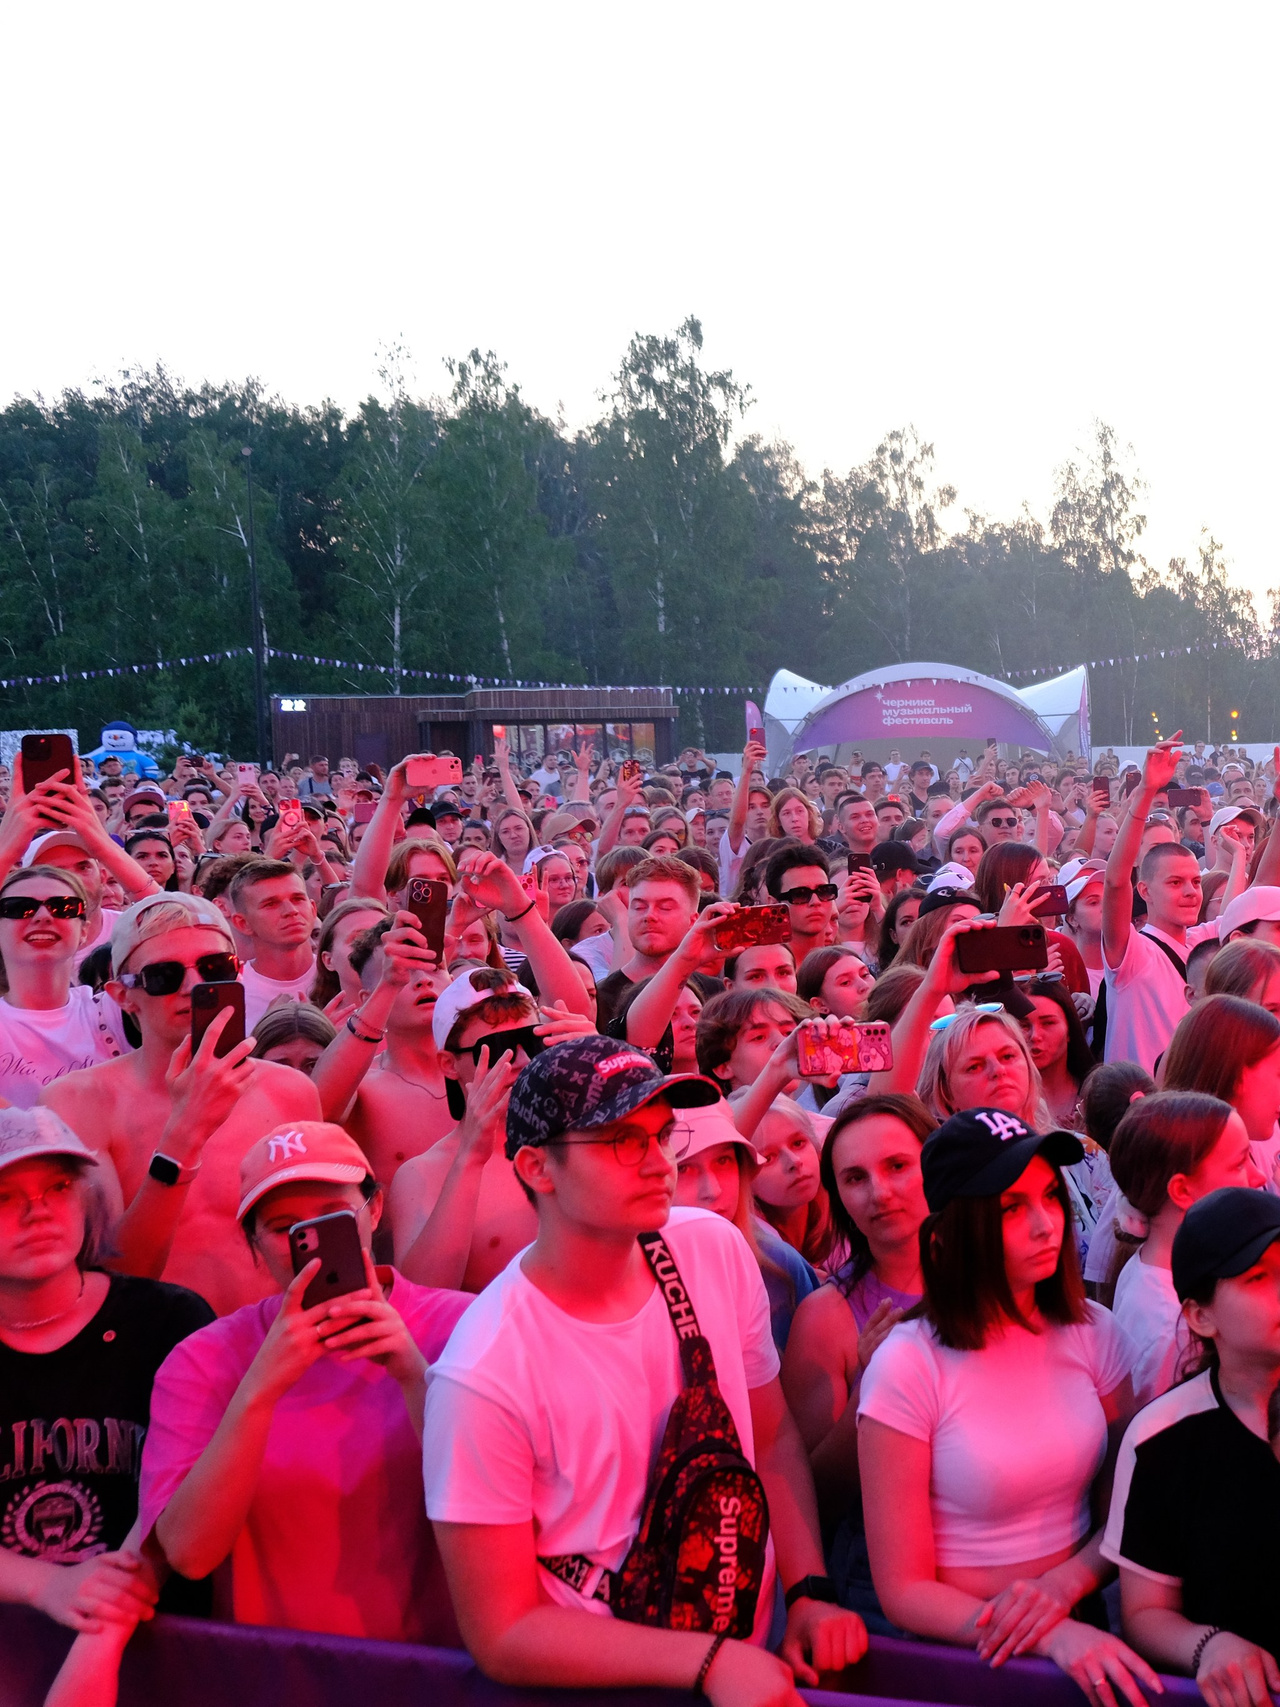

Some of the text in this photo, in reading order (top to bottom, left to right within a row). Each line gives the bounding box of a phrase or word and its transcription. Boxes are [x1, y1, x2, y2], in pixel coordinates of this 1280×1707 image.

[882, 699, 935, 708] черника
[882, 704, 973, 717] музыкальный
[882, 716, 954, 726] фестиваль
[975, 1112, 1027, 1141] LA
[268, 1131, 307, 1163] NY
[712, 1496, 741, 1632] Supreme
